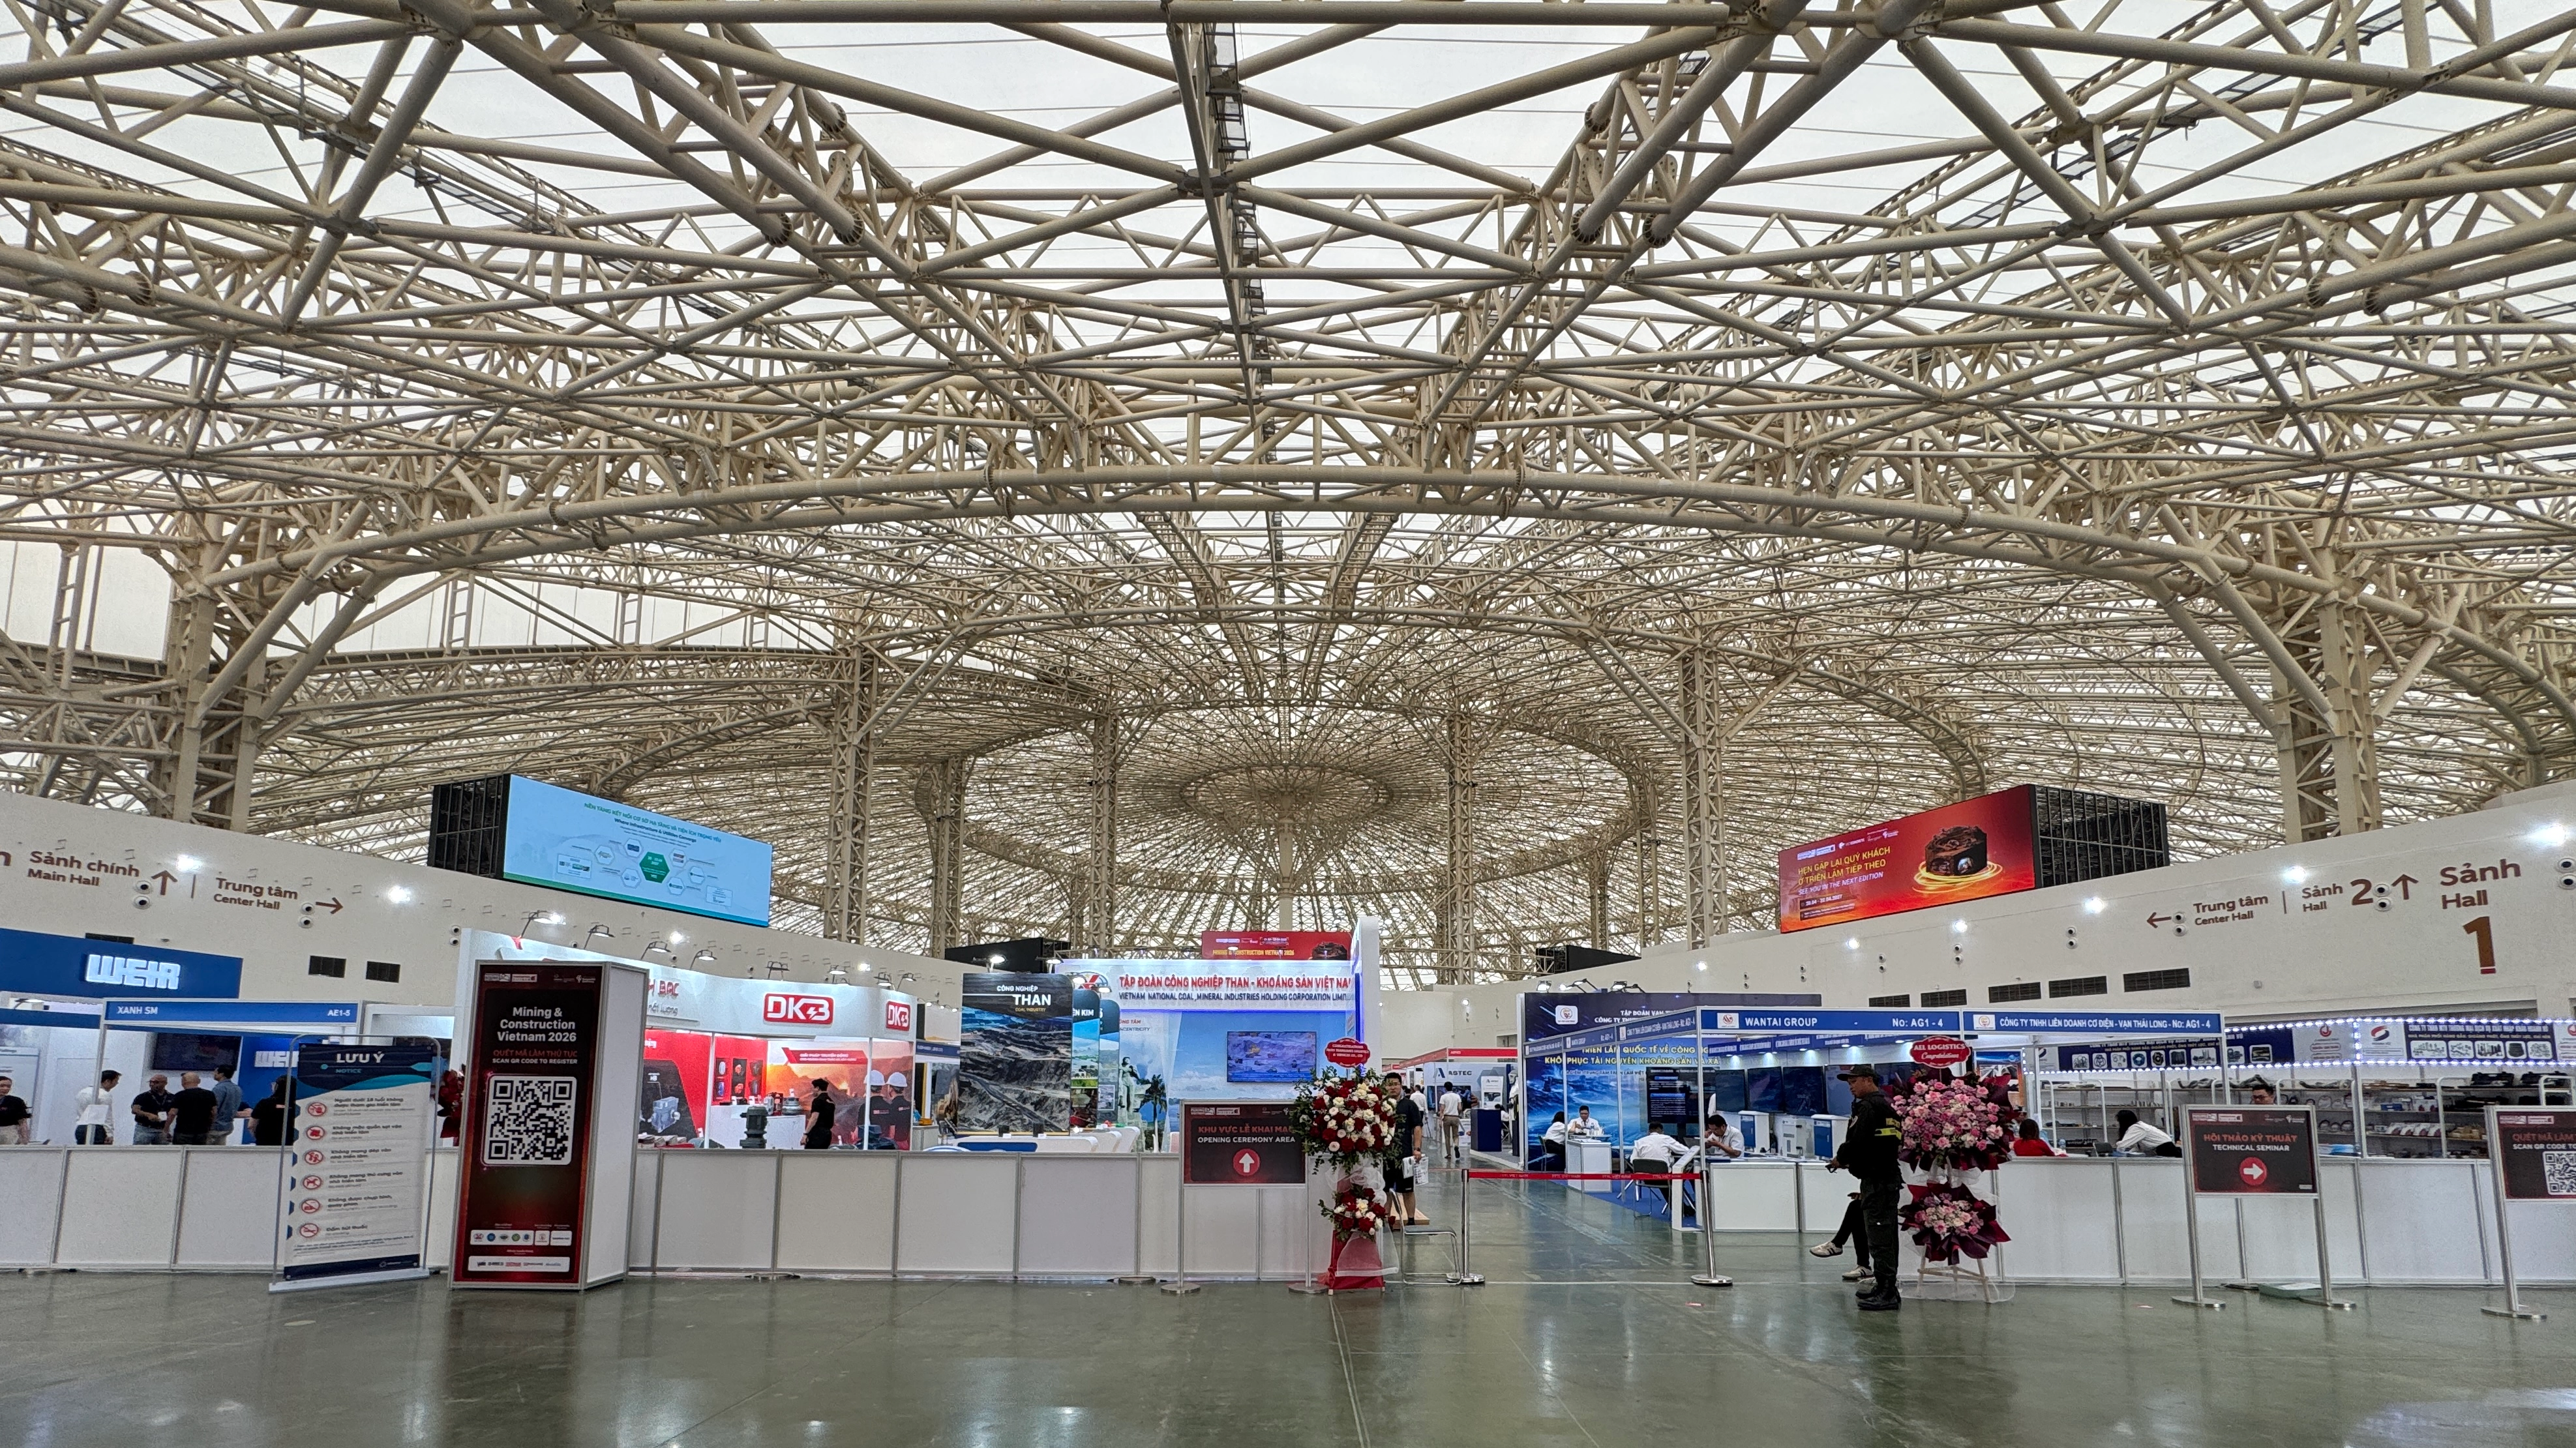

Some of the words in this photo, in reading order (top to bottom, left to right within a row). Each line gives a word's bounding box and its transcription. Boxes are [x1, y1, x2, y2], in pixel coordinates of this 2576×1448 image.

[30, 850, 81, 869] Sảnh
[87, 860, 140, 878] chính
[27, 868, 67, 883] Main
[70, 874, 99, 887] Hall
[2440, 859, 2521, 886] Sảnh
[216, 878, 263, 897] Trung
[268, 887, 298, 900] tâm
[2301, 883, 2343, 899] Sảnh
[2350, 879, 2373, 906] 2
[214, 893, 254, 906] Center
[257, 899, 280, 910] Hall
[2193, 900, 2236, 913] Trung
[2239, 896, 2268, 906] tâm
[2442, 889, 2489, 909] Hall
[2302, 901, 2327, 912] Hall
[2194, 915, 2230, 926] Center
[2232, 910, 2254, 921] Hall
[2463, 916, 2496, 974] 1
[85, 954, 181, 990] WEIR
[1336, 978, 1351, 988] NA
[1013, 994, 1051, 1006] THAN
[117, 1006, 142, 1015] XANH
[144, 1006, 158, 1015] SM
[513, 1007, 552, 1018] Mining
[554, 1008, 562, 1016] &
[500, 1020, 575, 1029] Construction
[1745, 1017, 1782, 1027] WANTAI
[1784, 1018, 1818, 1027] GROUP
[1892, 1018, 1908, 1027] No:
[1910, 1018, 1929, 1027] AG1
[1938, 1019, 1943, 1027] 4
[1999, 1017, 2019, 1027] CÔNG
[2020, 1019, 2028, 1027] TY
[2029, 1019, 2046, 1027] TNHH
[2048, 1017, 2062, 1027] LIÊN
[2088, 1018, 2097, 1028] CƠ
[2099, 1018, 2114, 1029] ĐIỆN
[2119, 1020, 2133, 1030] VẠN
[2134, 1018, 2148, 1028] THÁI
[2186, 1020, 2200, 1028] AG1
[497, 1031, 545, 1041] Vietnam
[548, 1032, 577, 1042] 2026
[336, 1053, 368, 1063] LƯU
[373, 1051, 385, 1063] Ý
[1219, 1125, 1238, 1134] VỰC
[1239, 1123, 1250, 1133] LỄ
[2204, 1132, 2220, 1142] HỘI
[2222, 1132, 2249, 1142] THẢO
[2251, 1133, 2263, 1142] KỸ
[2266, 1133, 2298, 1142] THUẬT
[2512, 1132, 2536, 1142] QUÉT
[2538, 1132, 2553, 1141] MÃ
